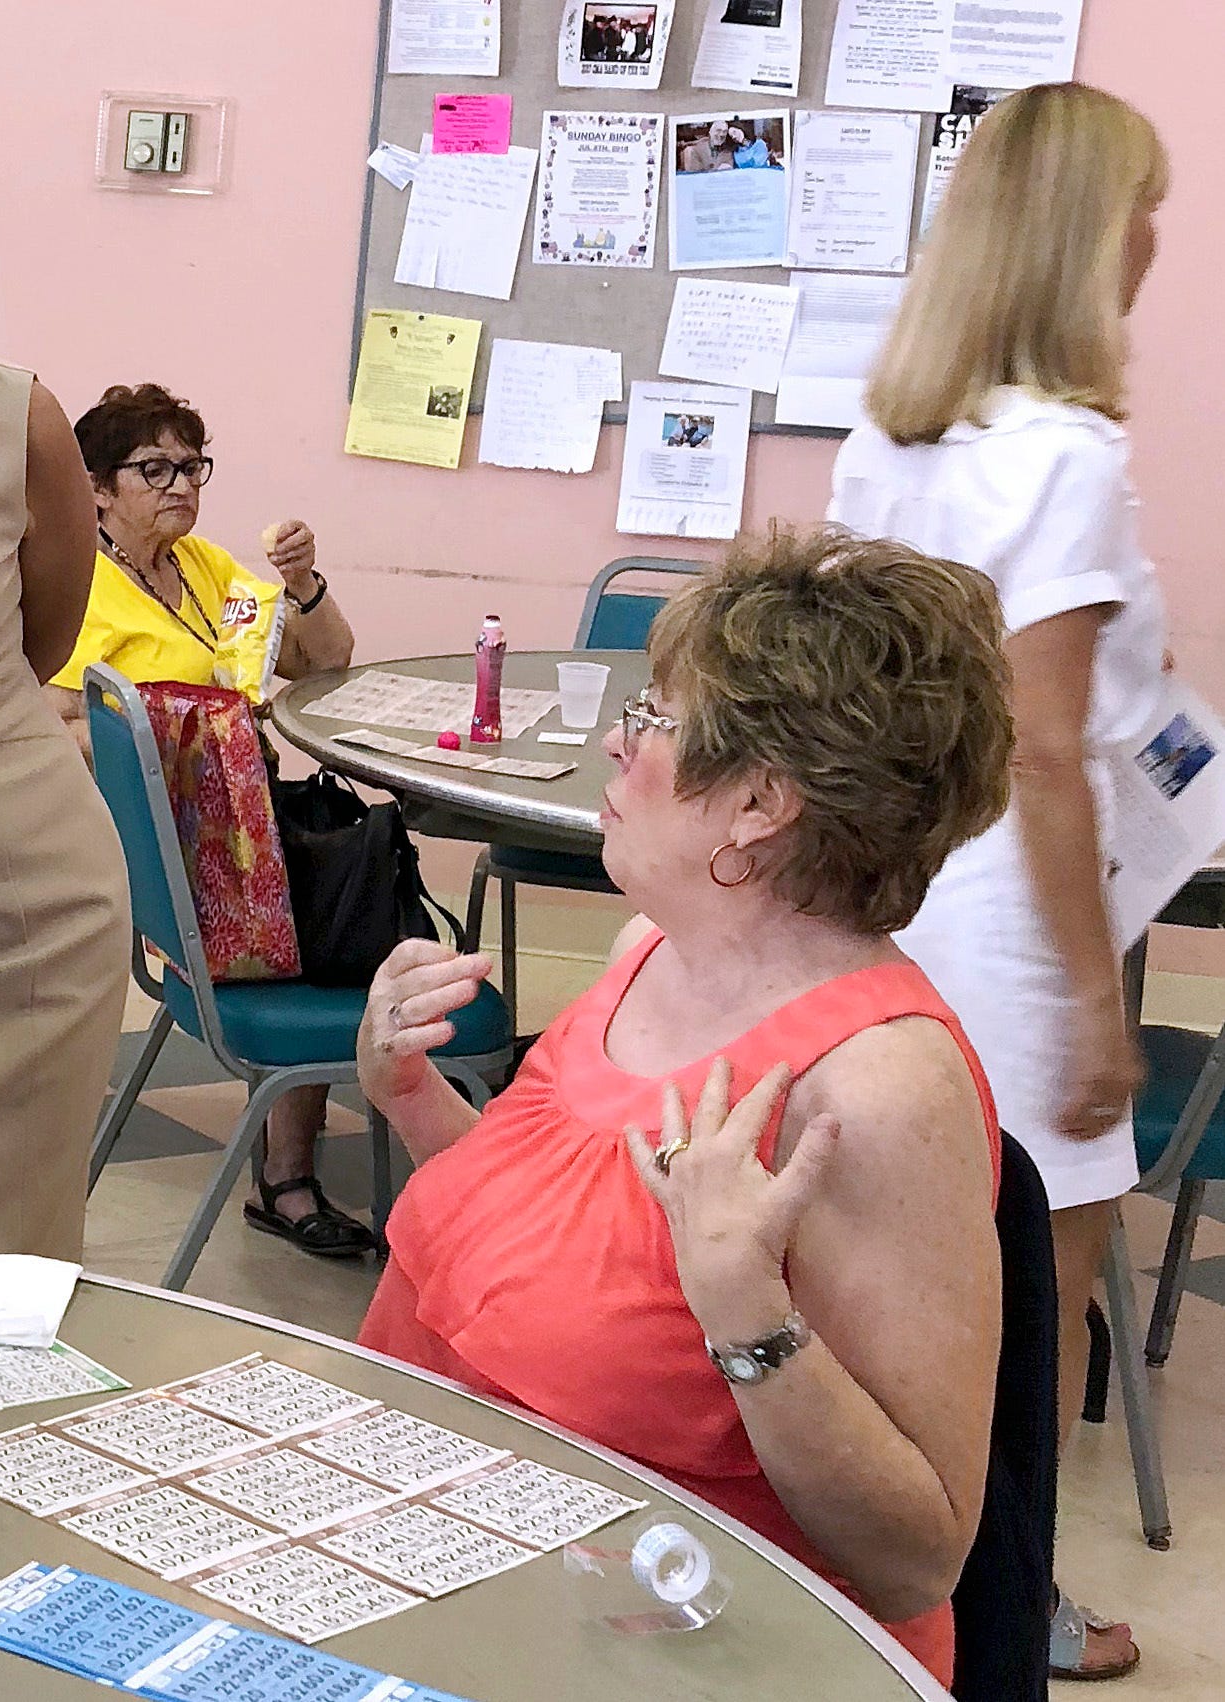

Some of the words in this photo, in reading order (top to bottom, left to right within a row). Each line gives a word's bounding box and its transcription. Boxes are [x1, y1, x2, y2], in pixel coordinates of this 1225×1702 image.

[567, 131, 606, 141] SUNDAY
[609, 132, 642, 142] BINGO
[941, 114, 981, 132] CA
[221, 600, 256, 627] ys
[281, 1402, 298, 1411] 42
[318, 1387, 340, 1397] 70
[33, 1436, 55, 1446] 74
[135, 1451, 145, 1460] 7
[148, 1444, 169, 1454] 22
[367, 1467, 392, 1478] 10
[387, 1461, 409, 1470] 21
[446, 1437, 466, 1448] 72
[213, 1471, 235, 1482] 17
[581, 1486, 604, 1497] 71
[67, 1518, 92, 1530] 14
[88, 1511, 114, 1522] 20
[113, 1504, 132, 1513] 42
[153, 1489, 179, 1500] 73
[109, 1520, 132, 1533] 27
[133, 1514, 156, 1524] 41
[177, 1499, 199, 1510] 74
[114, 1539, 129, 1547] 4
[130, 1531, 152, 1542] 22
[176, 1515, 196, 1526] 47
[198, 1508, 221, 1519] 70
[373, 1560, 391, 1569] 1
[453, 1525, 476, 1538] 72
[201, 1581, 226, 1593] 10
[221, 1573, 246, 1584] 21
[245, 1564, 266, 1574] 42
[7, 1627, 25, 1636] 2
[22, 1613, 44, 1625] 19
[75, 1581, 98, 1594] 63
[44, 1622, 70, 1636] 24
[64, 1611, 88, 1625] 42
[98, 1587, 119, 1602] 67
[68, 1631, 94, 1644] 20
[105, 1607, 125, 1622] 47
[121, 1596, 146, 1611] 62
[127, 1615, 149, 1630] 57
[144, 1604, 169, 1619] 73
[137, 1636, 159, 1649] 41
[152, 1625, 177, 1638] 60
[170, 1613, 193, 1627] 65
[189, 1671, 210, 1684] 17
